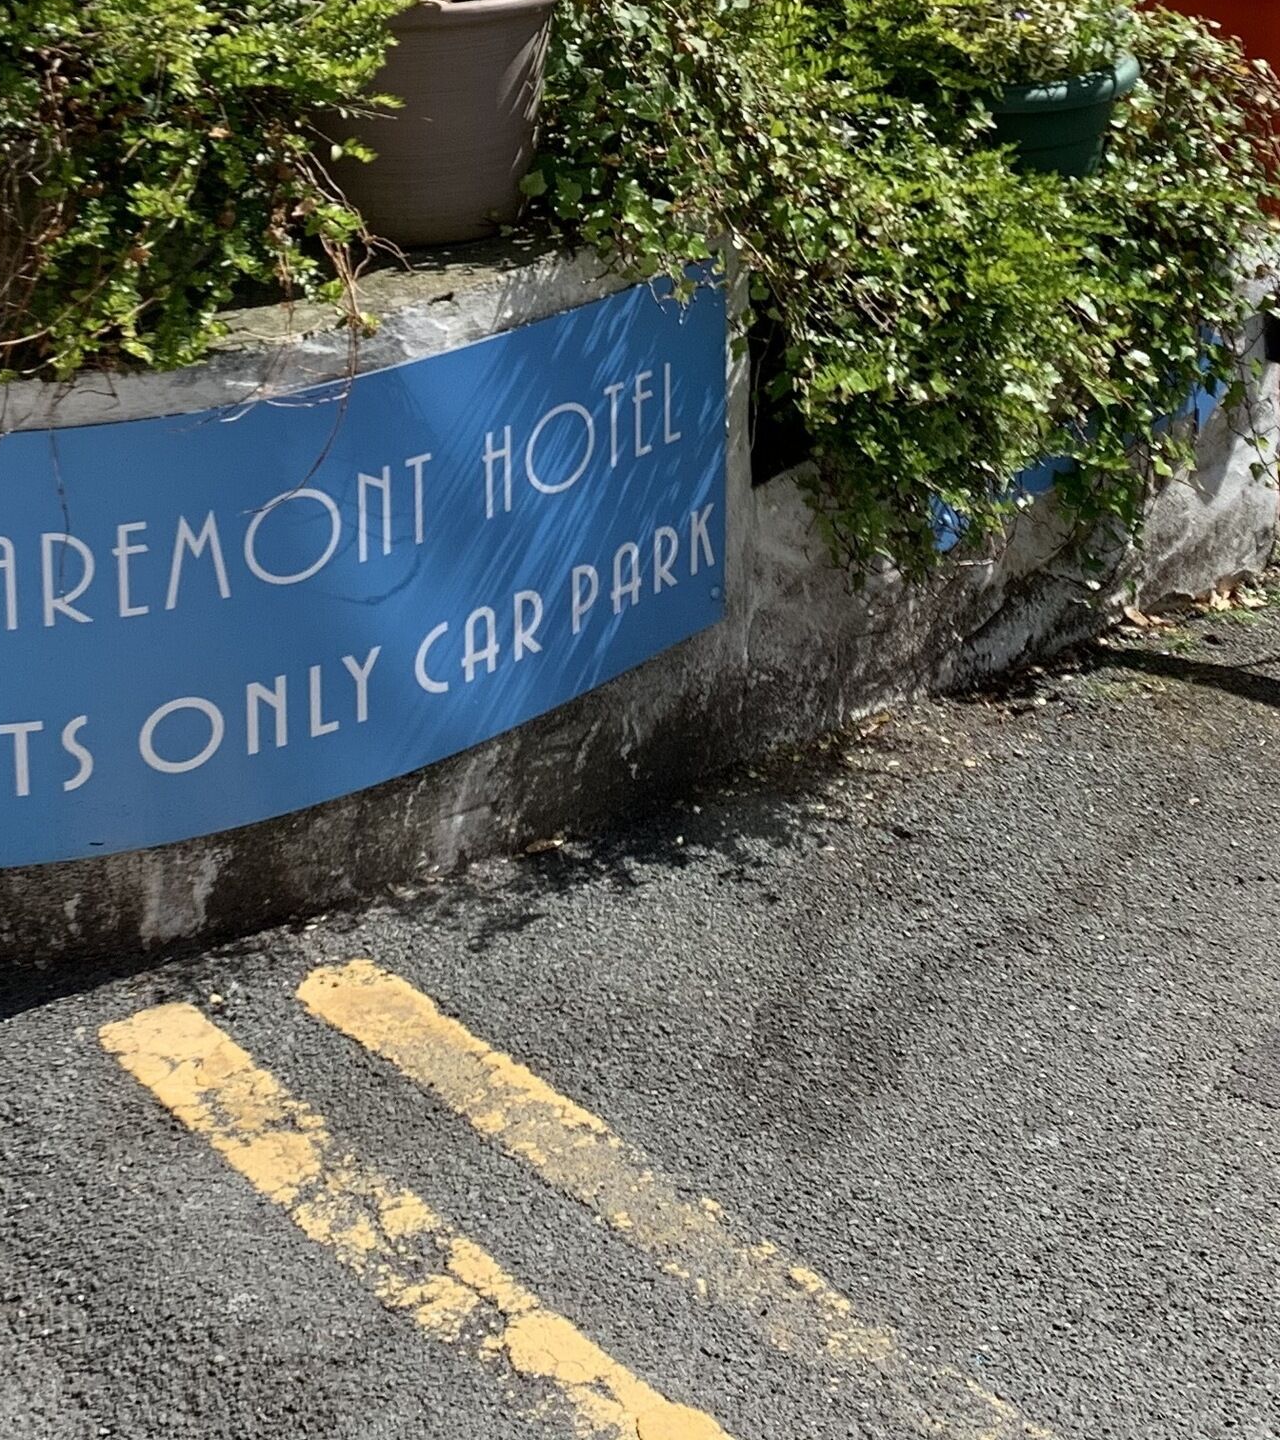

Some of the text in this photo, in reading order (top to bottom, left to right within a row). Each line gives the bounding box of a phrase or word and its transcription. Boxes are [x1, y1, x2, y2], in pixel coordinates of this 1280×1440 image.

[482, 363, 682, 520] HOTEL
[139, 646, 382, 774] ONLY
[414, 590, 543, 694] CAR
[571, 503, 716, 636] PARK
